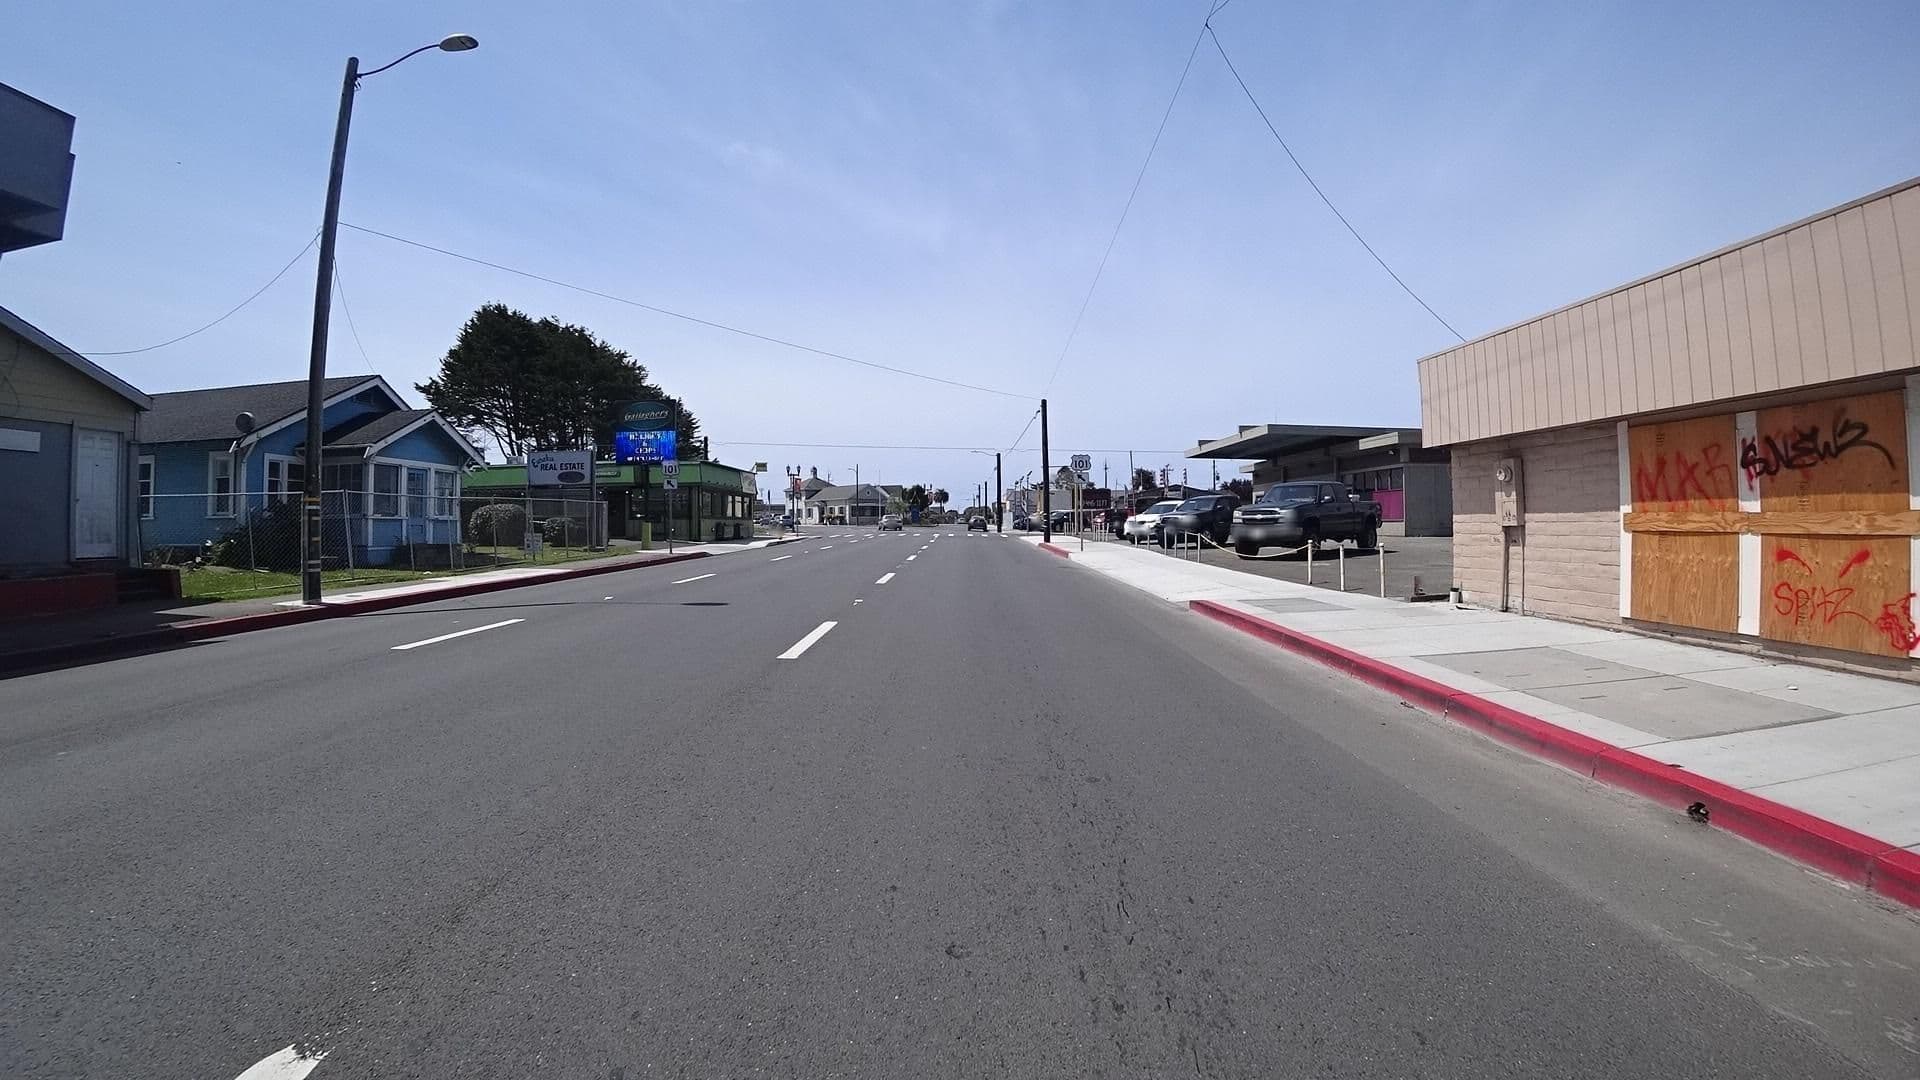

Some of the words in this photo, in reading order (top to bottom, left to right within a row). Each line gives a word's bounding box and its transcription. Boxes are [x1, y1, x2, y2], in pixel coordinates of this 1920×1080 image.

[540, 463, 558, 471] REAL
[559, 462, 585, 471] ESTATE
[1074, 460, 1088, 468] 101
[664, 465, 677, 474] 101
